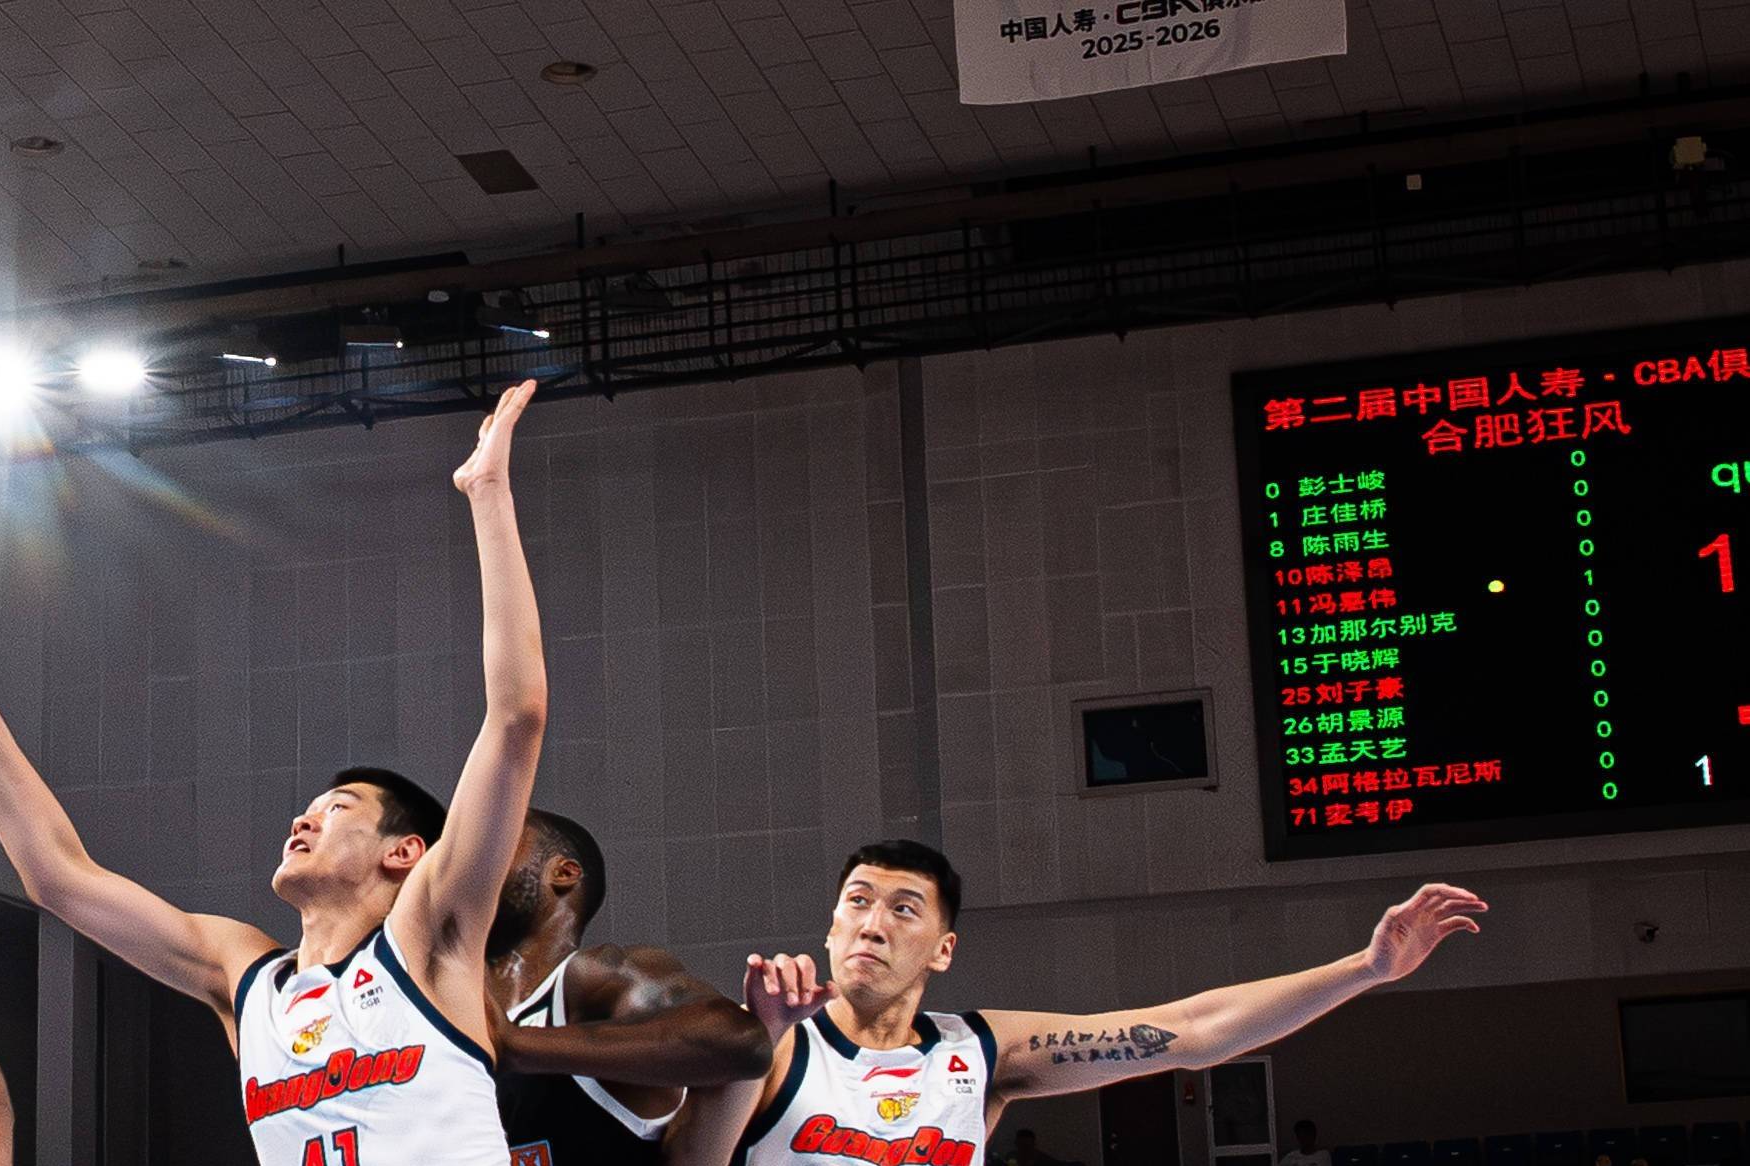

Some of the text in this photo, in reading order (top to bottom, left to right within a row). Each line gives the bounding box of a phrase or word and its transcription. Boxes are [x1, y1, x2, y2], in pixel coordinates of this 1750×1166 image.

[1081, 19, 1221, 59] 2025-2026
[1421, 400, 1632, 455] 合肥狂风
[1570, 450, 1586, 467] 0
[1266, 470, 1386, 499] 0 彭士峻
[1711, 460, 1750, 493] q
[1573, 479, 1589, 496] 0
[1269, 498, 1387, 528] 1 庄佳桥
[1576, 509, 1592, 526] 0
[1270, 529, 1390, 557] 8 陈雨生
[1579, 539, 1595, 556] 0
[1584, 569, 1593, 586] 1
[1585, 599, 1600, 616] 0
[1588, 629, 1603, 646] 0
[1591, 660, 1606, 677] 0
[1594, 690, 1609, 707] 0
[1597, 720, 1612, 738] 0
[1599, 751, 1615, 769] 0
[1602, 782, 1618, 799] 0
